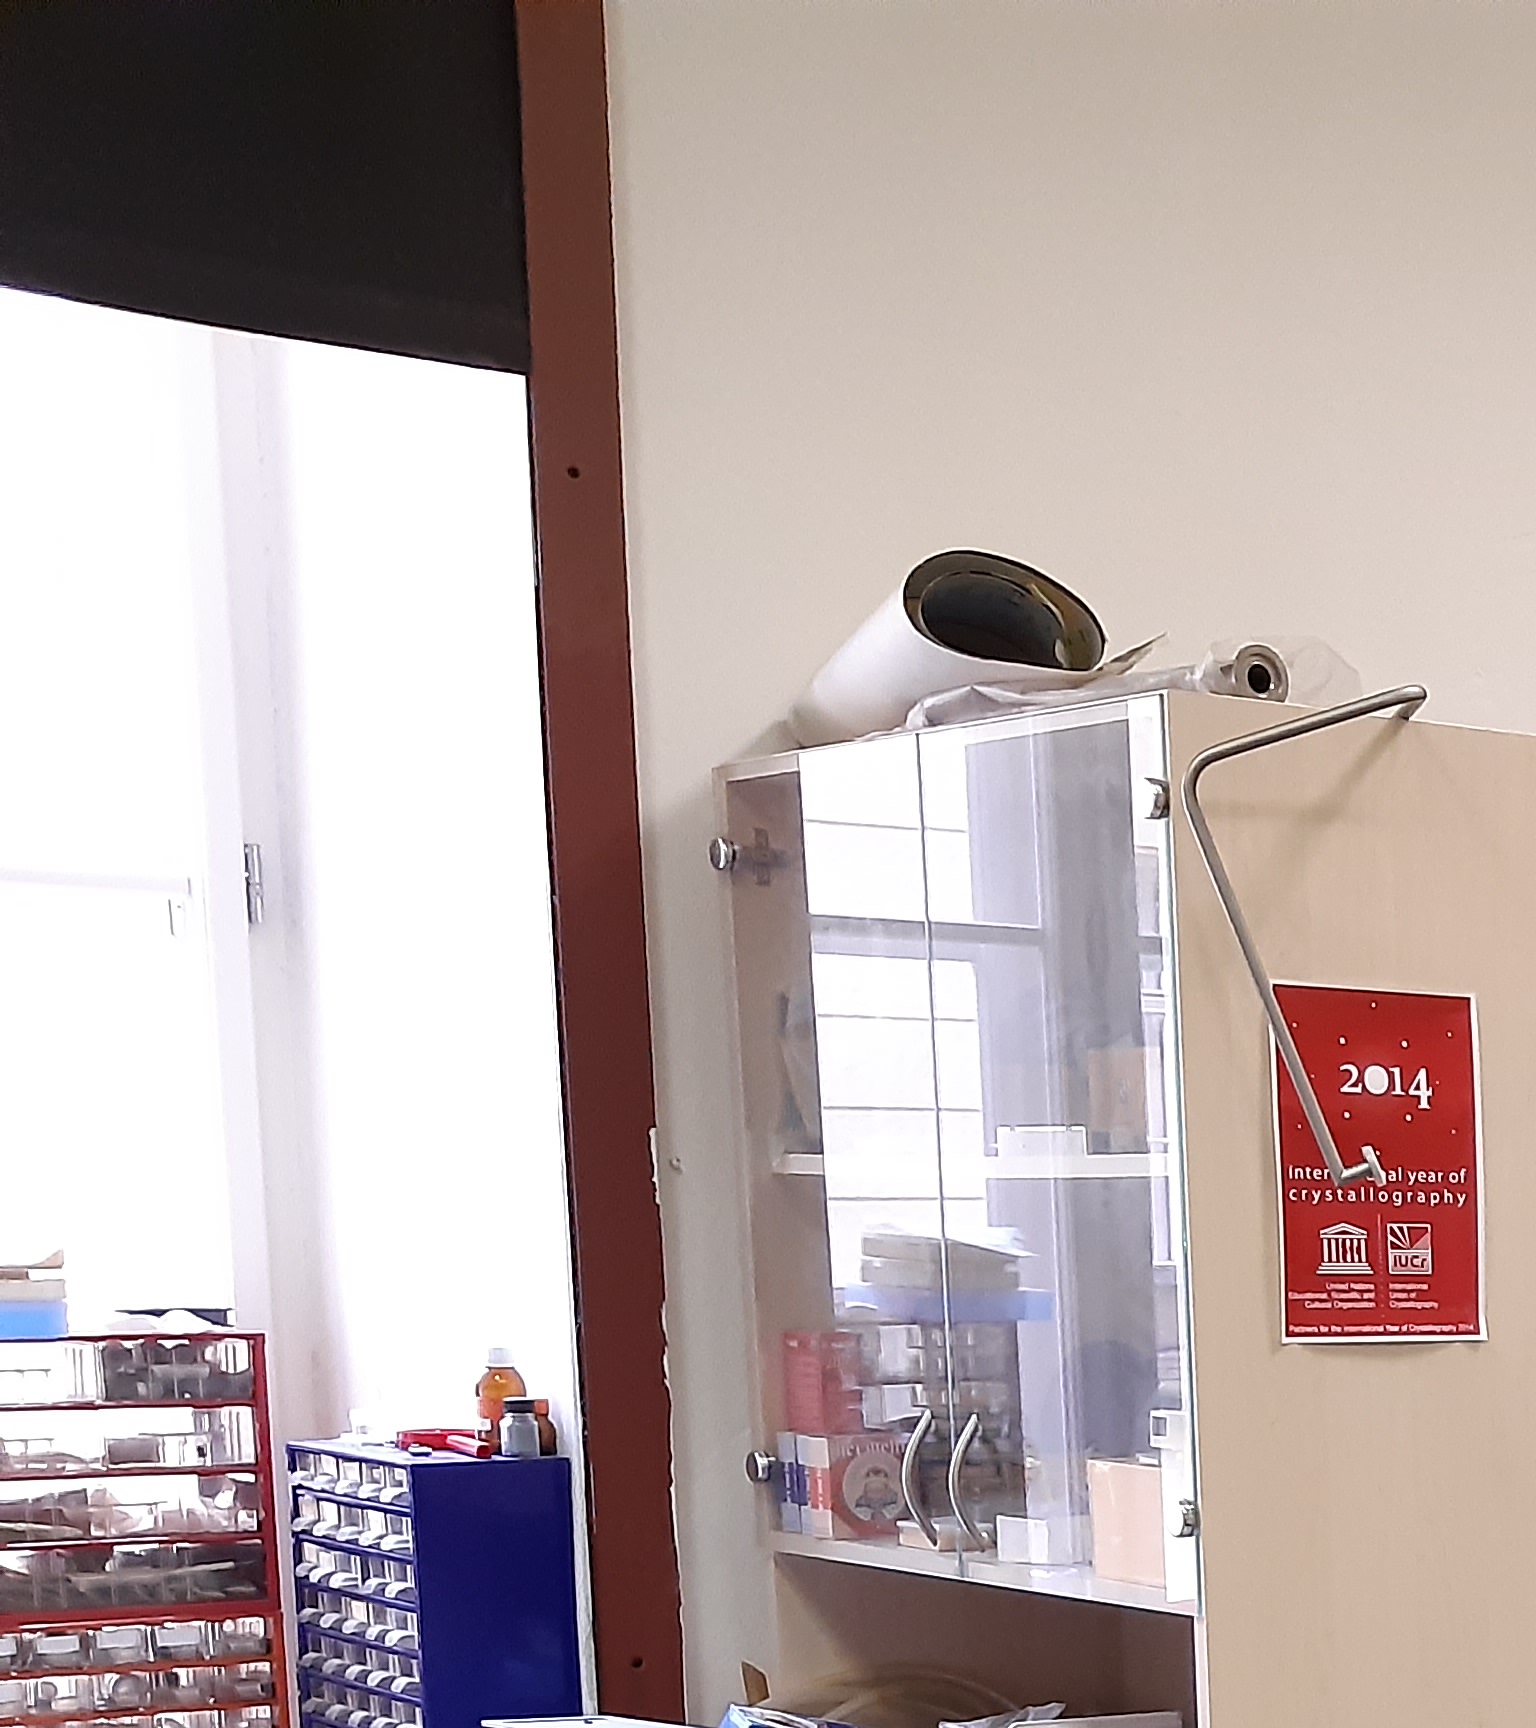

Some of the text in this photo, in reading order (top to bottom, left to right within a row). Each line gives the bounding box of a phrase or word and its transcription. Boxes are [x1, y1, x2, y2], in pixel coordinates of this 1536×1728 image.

[1339, 1063, 1433, 1109] 2014
[1407, 1170, 1444, 1186] year
[1448, 1167, 1467, 1184] of
[1288, 1186, 1466, 1208] crystallography
[1393, 1254, 1428, 1269] IUCr
